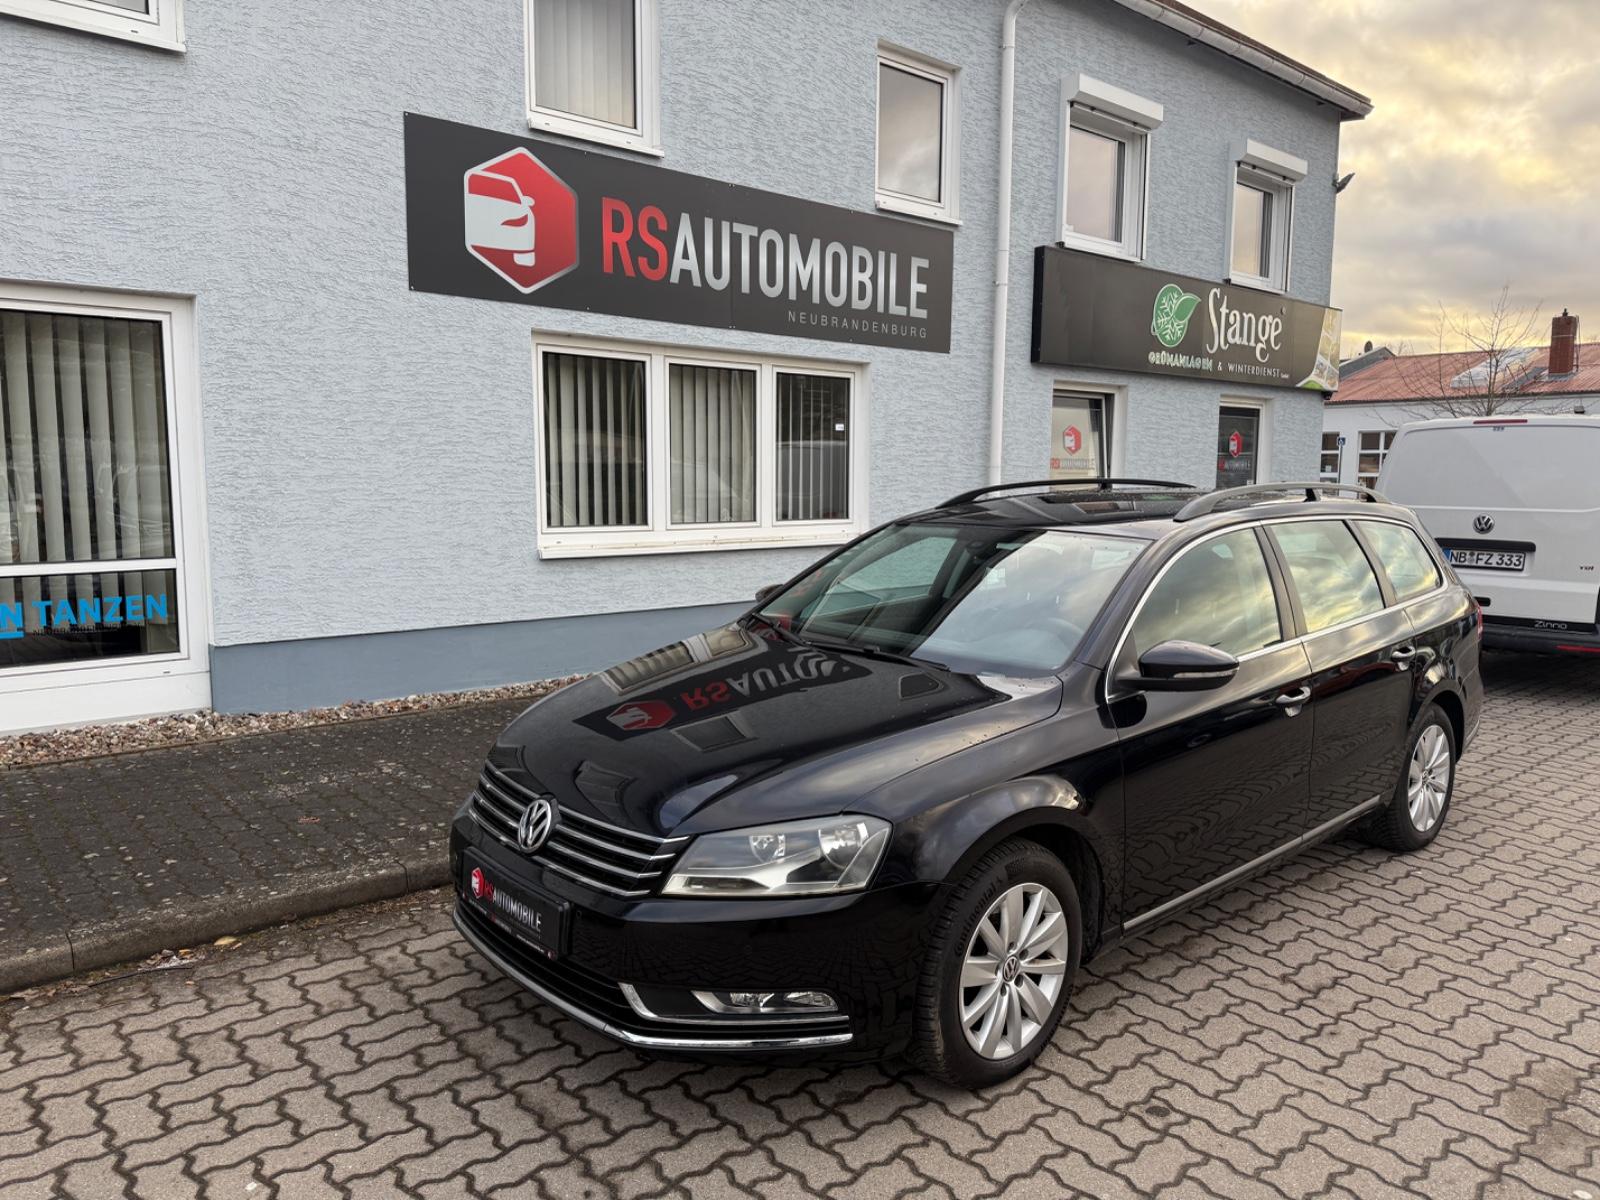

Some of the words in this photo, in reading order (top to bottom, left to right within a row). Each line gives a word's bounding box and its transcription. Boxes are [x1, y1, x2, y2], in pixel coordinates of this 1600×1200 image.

[787, 310, 929, 341] NEUBRANDENBURG
[1206, 287, 1283, 363] Stange
[1217, 361, 1223, 371] &
[1228, 362, 1280, 378] WINTERDIENST
[1450, 551, 1467, 564] NB
[1475, 552, 1494, 566] FZ
[1496, 553, 1522, 567] 333
[31, 593, 168, 627] TANZEN
[1534, 620, 1568, 631] Zinno
